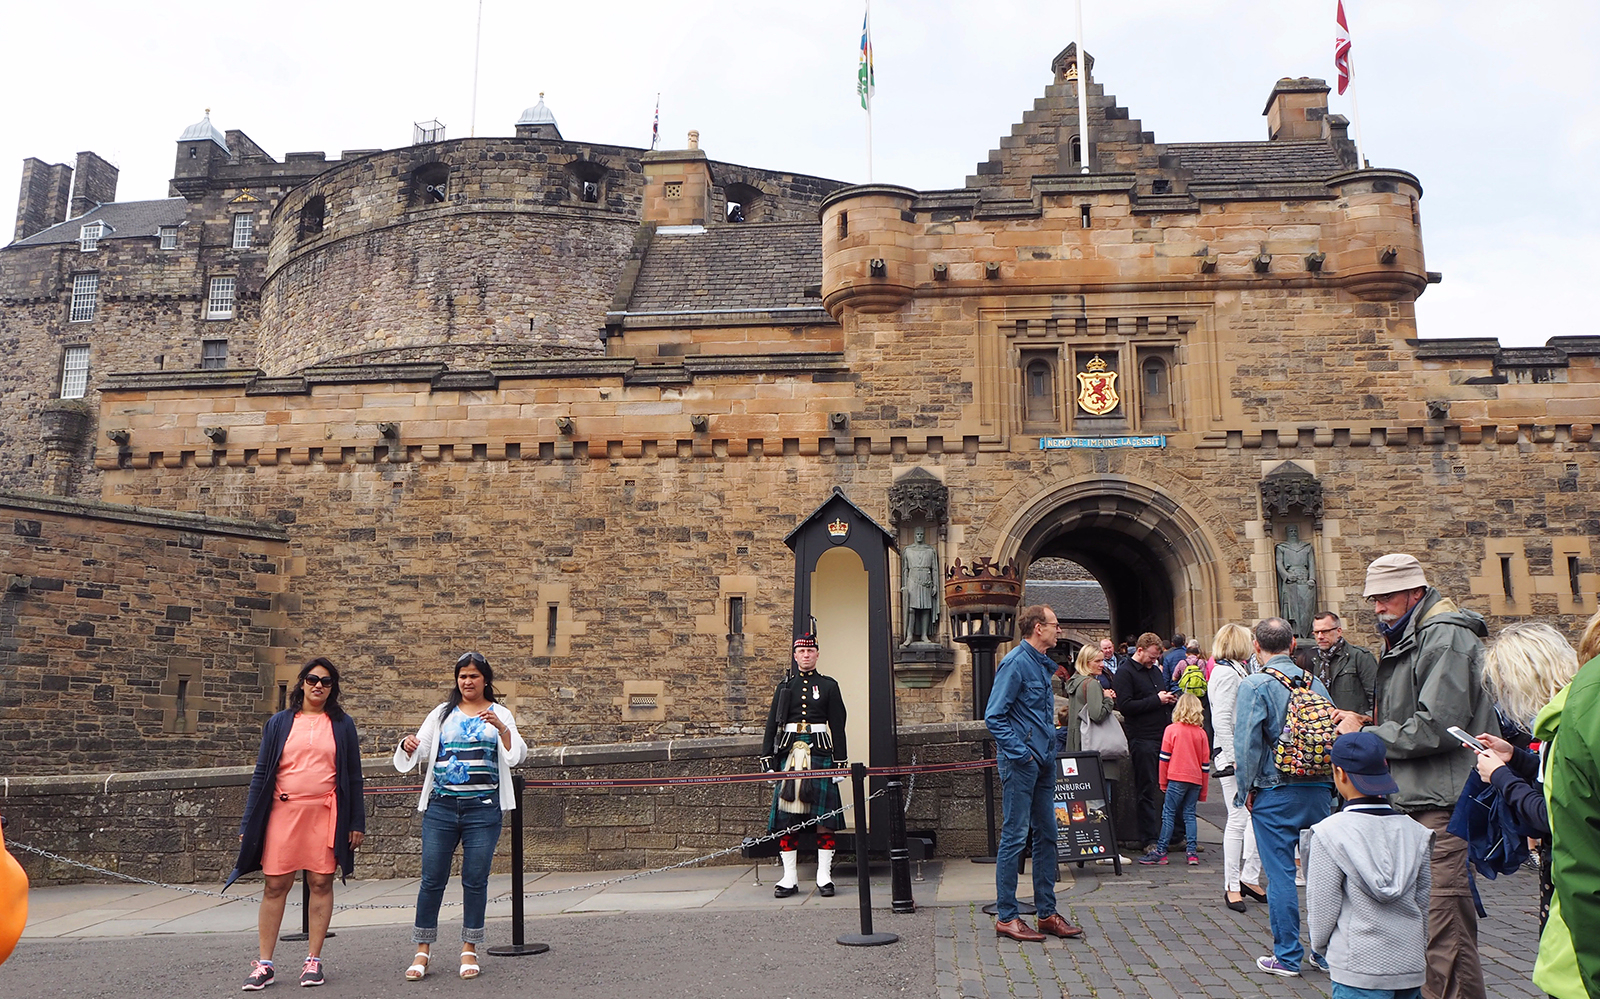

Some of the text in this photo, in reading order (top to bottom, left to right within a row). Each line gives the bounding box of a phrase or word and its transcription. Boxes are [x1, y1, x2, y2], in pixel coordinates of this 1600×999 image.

[1047, 437, 1160, 447] NEMO ME IMPUNE LACESSIT
[1053, 792, 1075, 801] ASTLE
